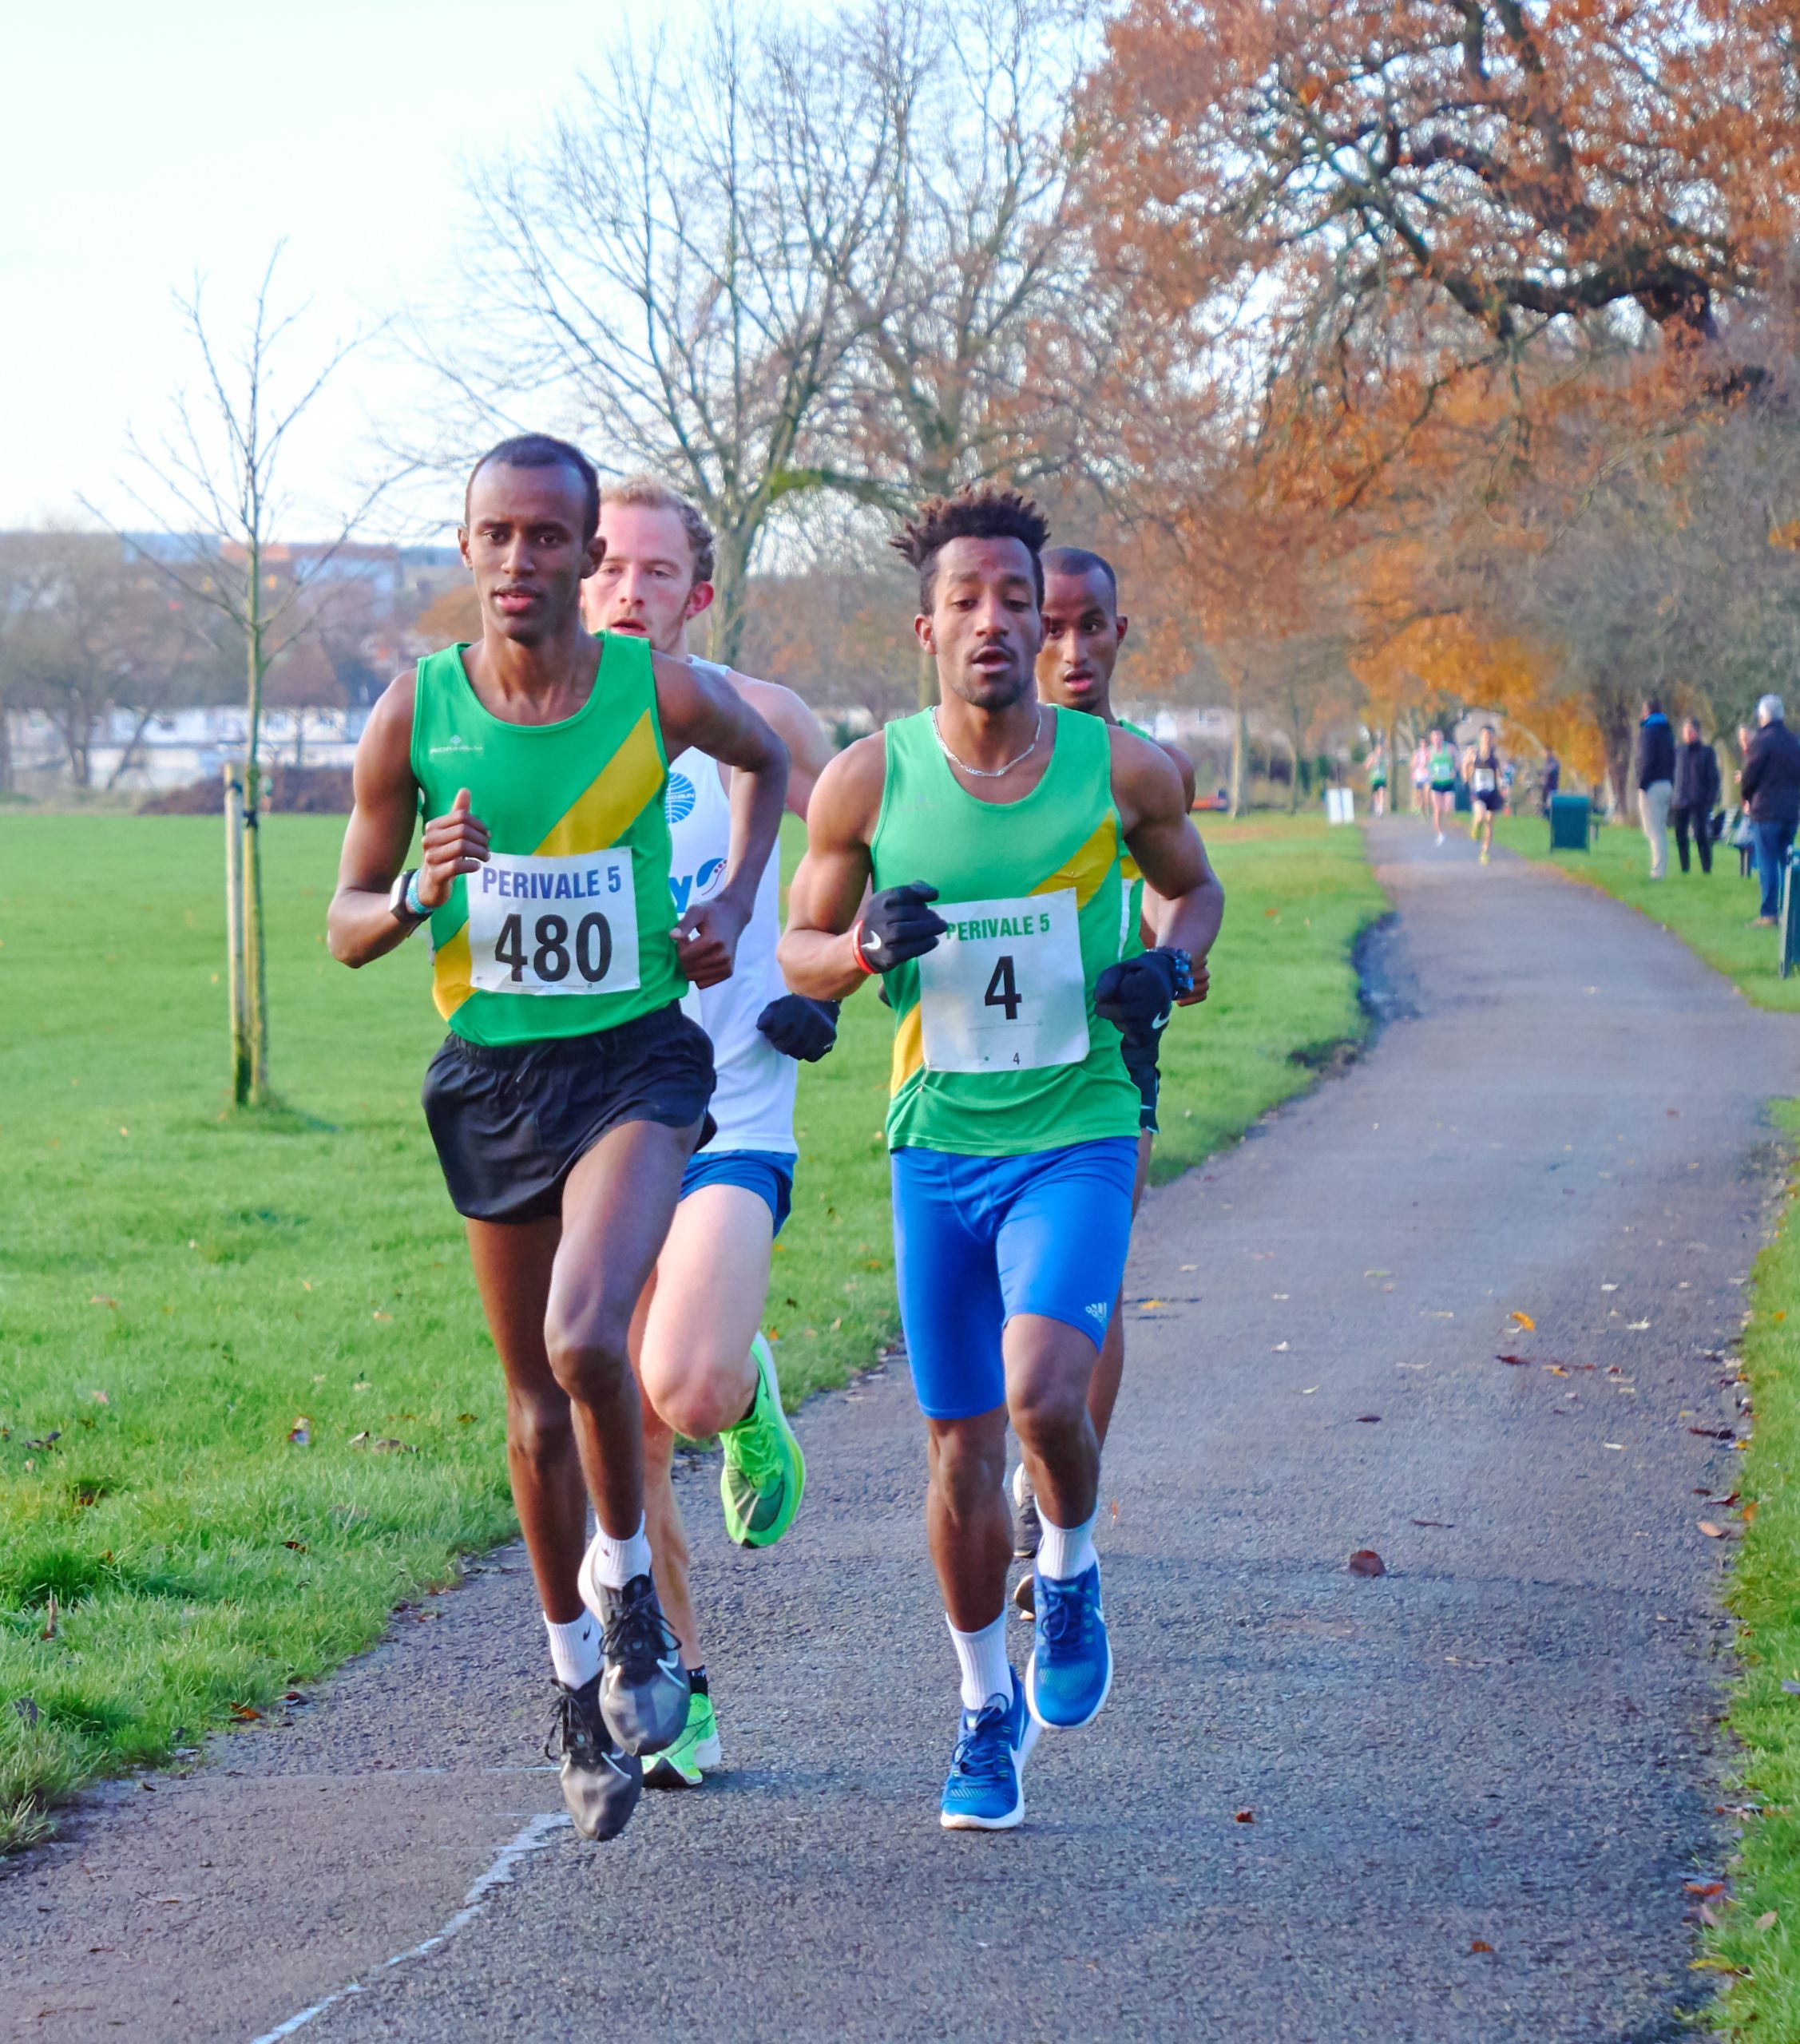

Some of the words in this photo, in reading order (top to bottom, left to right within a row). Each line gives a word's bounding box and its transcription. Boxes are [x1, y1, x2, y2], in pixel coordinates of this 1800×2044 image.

[482, 866, 601, 900] PERIVALE
[607, 865, 622, 893] 5
[946, 915, 1034, 941] PERIVALE
[1040, 913, 1050, 933] 5
[494, 911, 613, 983] 480
[985, 955, 1023, 1020] 4
[1013, 1052, 1021, 1065] 4
